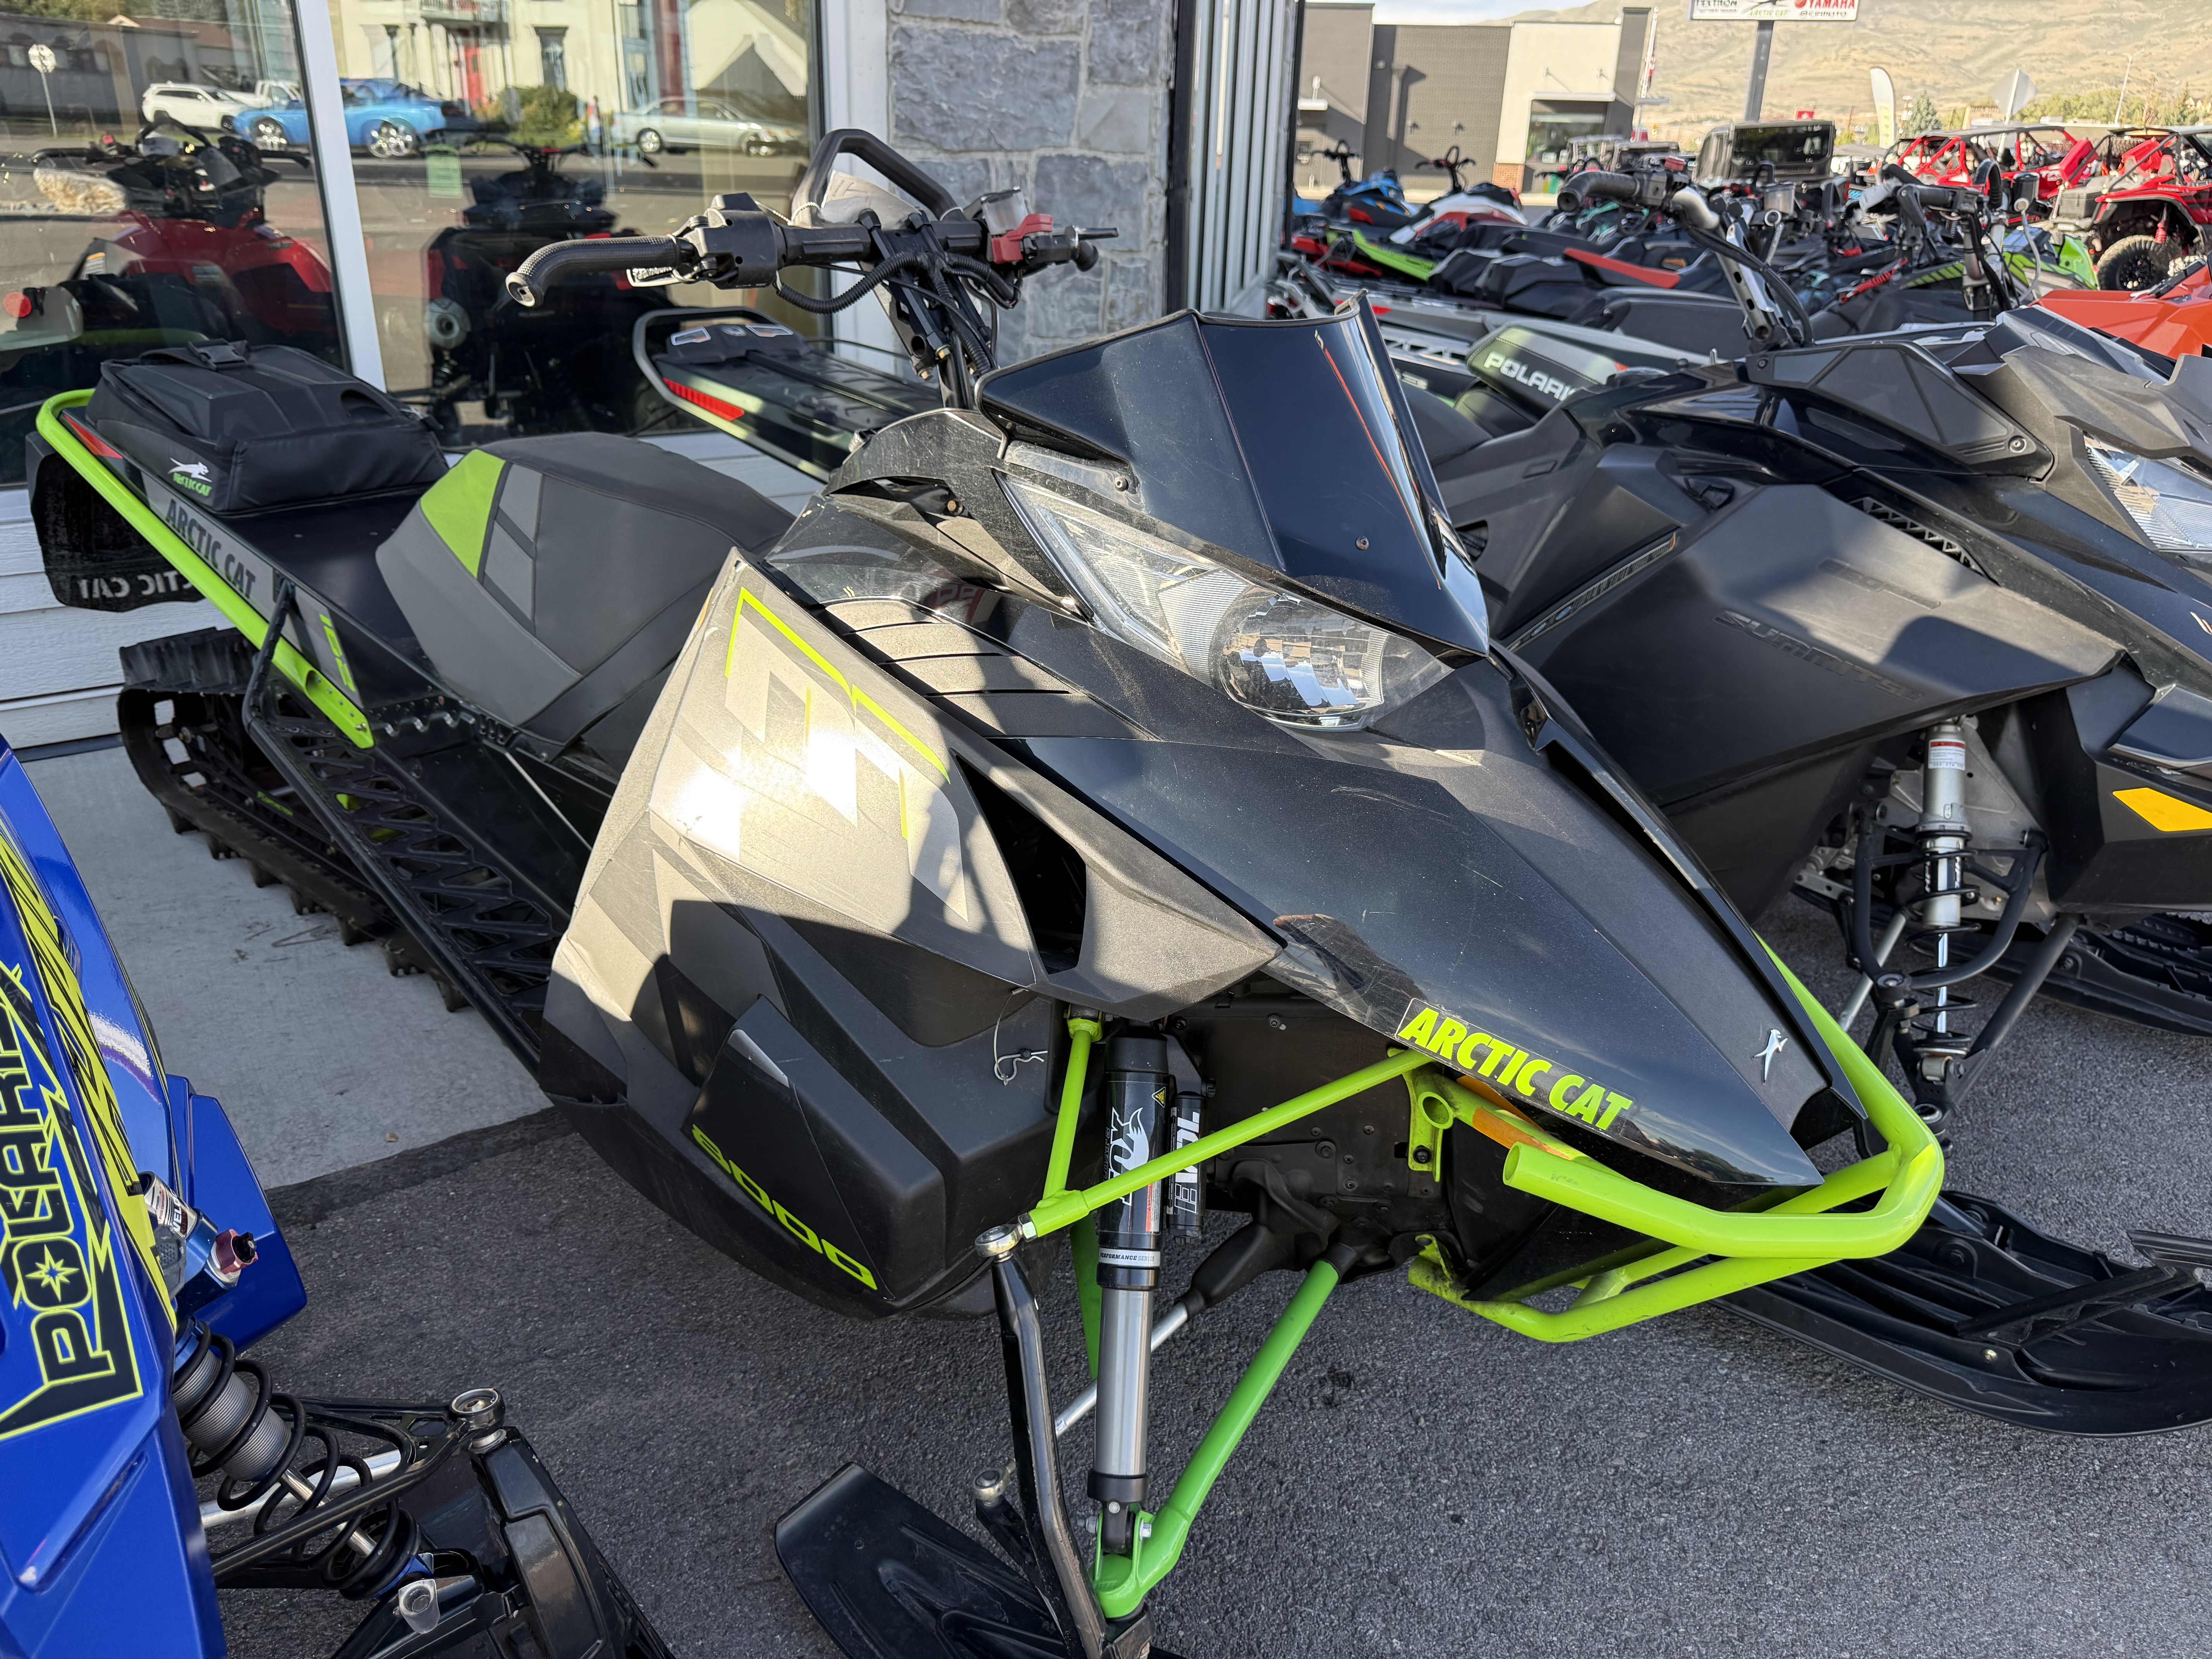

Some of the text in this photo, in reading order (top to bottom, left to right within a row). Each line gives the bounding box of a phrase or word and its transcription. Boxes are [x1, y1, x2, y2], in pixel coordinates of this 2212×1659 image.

[1484, 351, 1577, 401] POLARI
[165, 498, 256, 599] ARCTIC CAT
[1713, 610, 1882, 684] SUMMIT
[1397, 1007, 1633, 1130] ARCTIC CAT
[0, 1002, 115, 1383] POLARI
[692, 1123, 878, 1290] 8000
